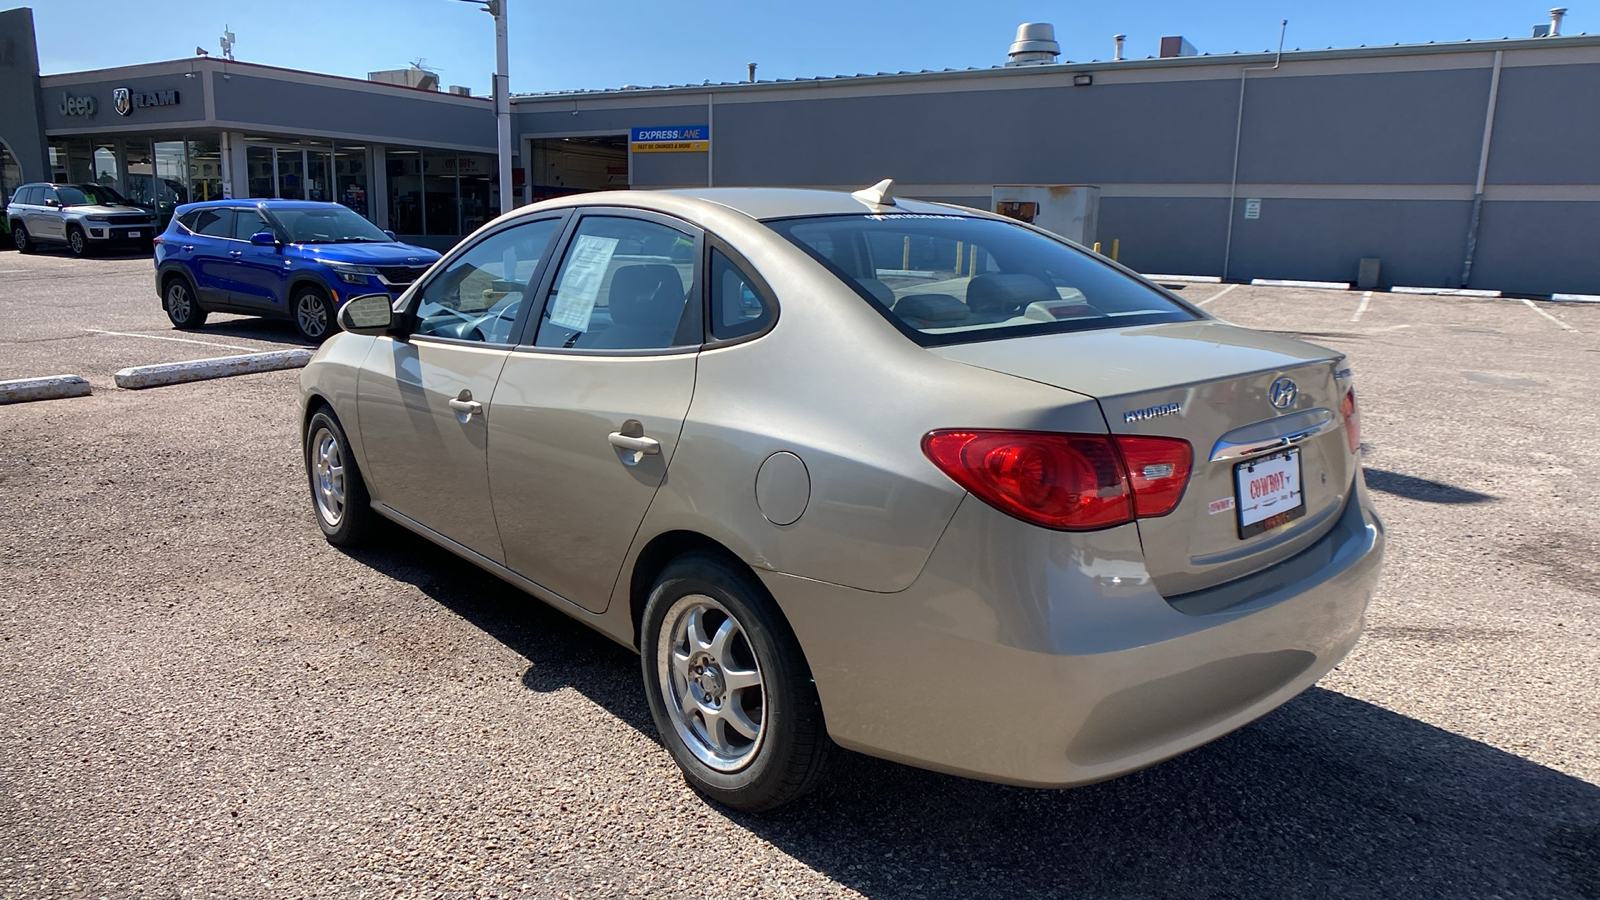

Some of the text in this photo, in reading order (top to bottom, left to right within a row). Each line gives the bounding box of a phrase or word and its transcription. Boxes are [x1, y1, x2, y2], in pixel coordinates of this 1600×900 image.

[58, 91, 95, 119] Jeep
[131, 90, 180, 108] RAM
[1124, 402, 1182, 423] HYUNDAI
[1249, 471, 1285, 500] COWBOY
